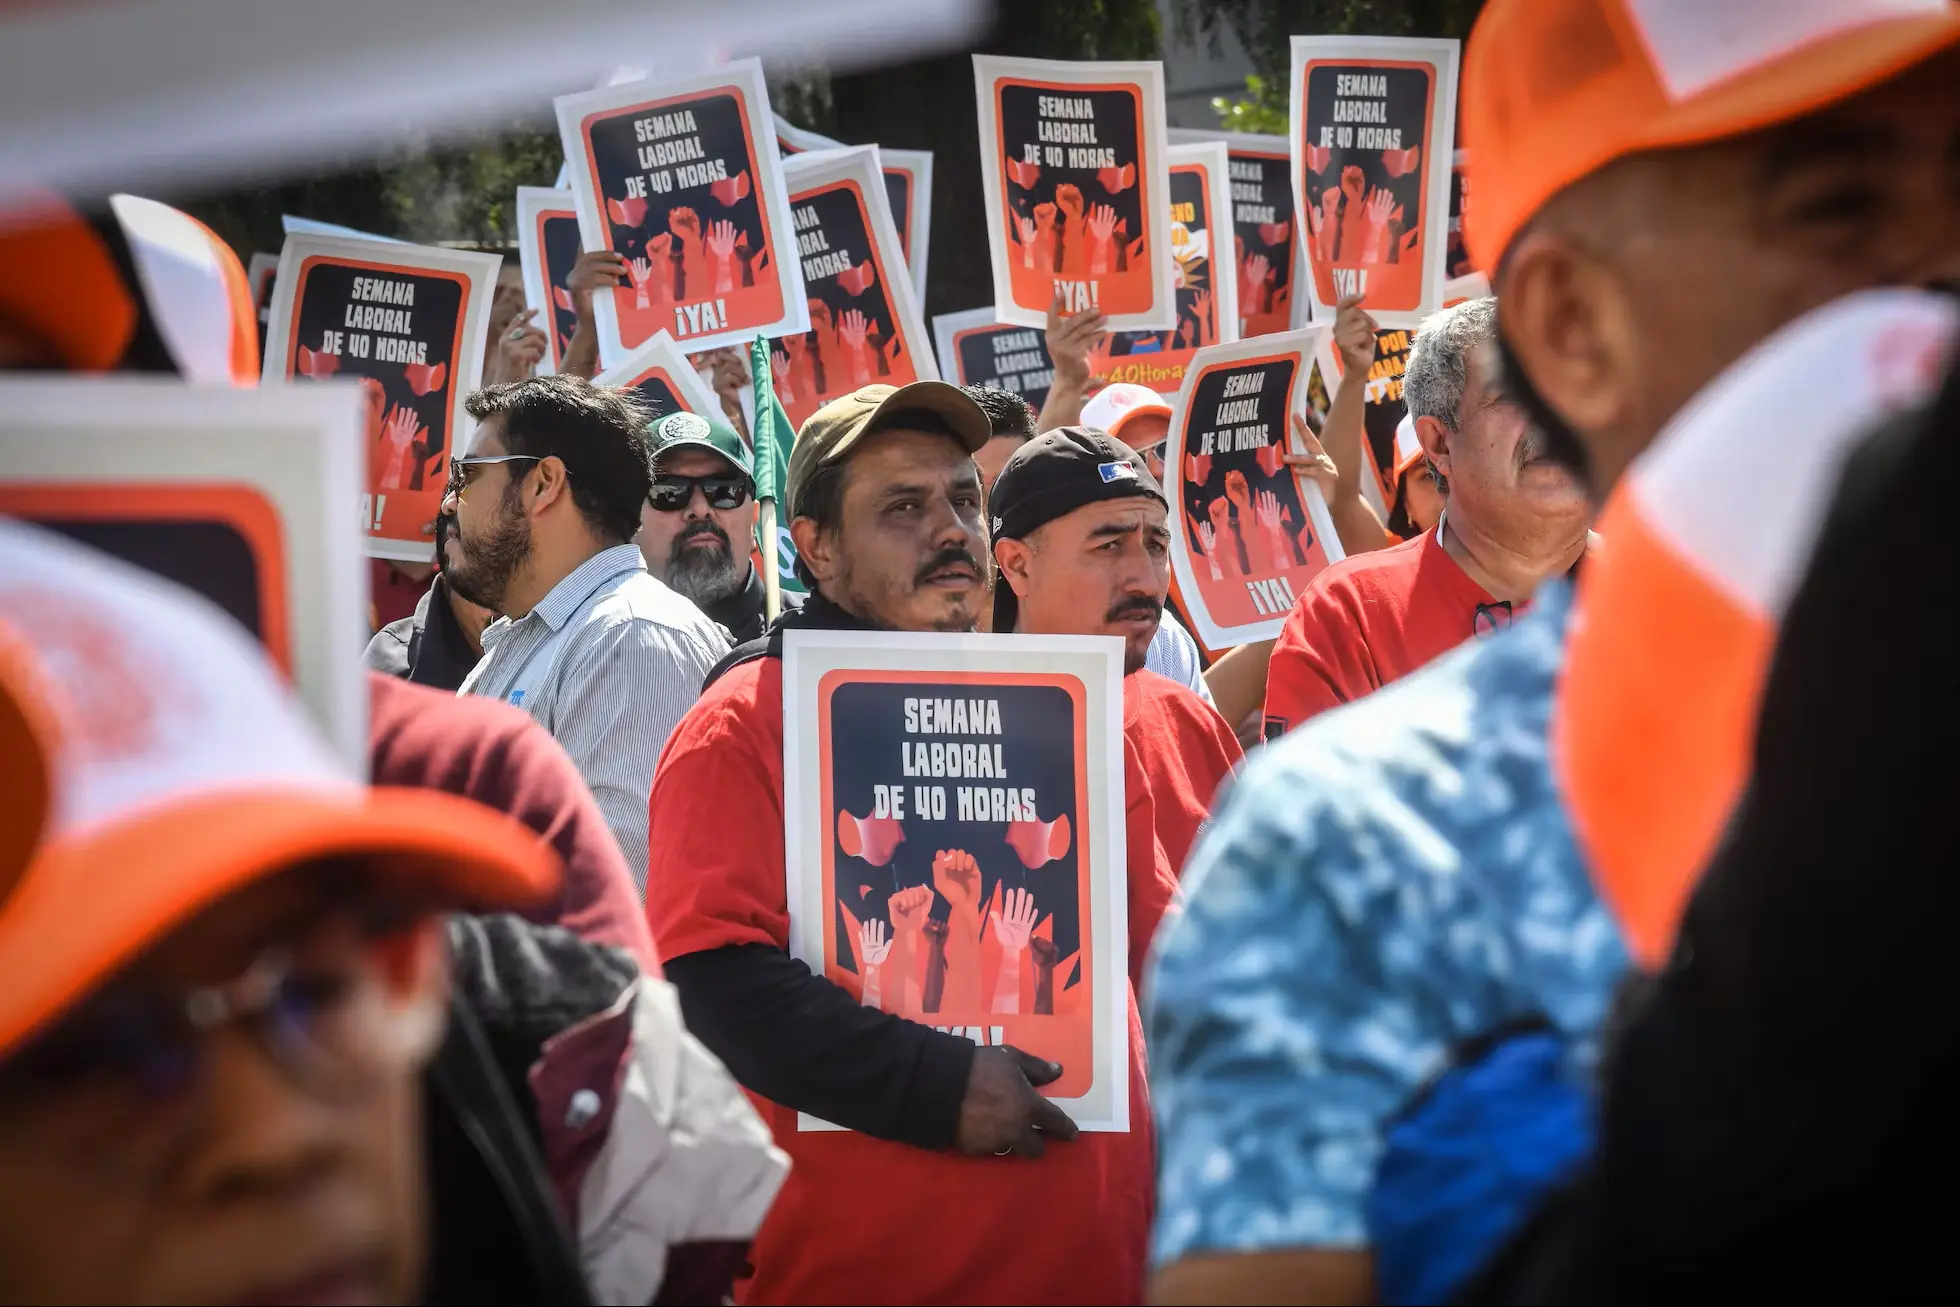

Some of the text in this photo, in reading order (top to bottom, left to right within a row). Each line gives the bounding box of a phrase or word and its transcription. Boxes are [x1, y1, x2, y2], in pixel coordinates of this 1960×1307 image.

[1336, 74, 1387, 97] SEMANA
[1038, 95, 1094, 119] SEMANA
[1333, 100, 1387, 123] LABORAL
[634, 110, 697, 142] SEMANA
[1038, 121, 1098, 144] LABORAL
[1320, 126, 1402, 150] DE 40 HORAS
[637, 136, 705, 170] LABORAL
[1024, 143, 1115, 169] DE 40 HORAS
[625, 158, 728, 199] DE 40 HORAS
[1236, 204, 1276, 224] HORAS
[803, 249, 852, 281] HORAS
[352, 276, 415, 306] SEMANA
[345, 304, 412, 335] LABORAL
[674, 299, 728, 337] ¡YA!
[322, 330, 428, 365] DE 40 HORAS
[992, 331, 1039, 354] SEMANA
[995, 350, 1044, 375] LABORAL
[1223, 371, 1265, 399] SEMANA
[1216, 397, 1260, 426] LABORAL
[1200, 424, 1268, 456] DE 40 HORAS
[904, 697, 1002, 735] SEMANA
[902, 741, 1006, 779] LABORAL
[874, 784, 1036, 823] DE 40 HORAS
